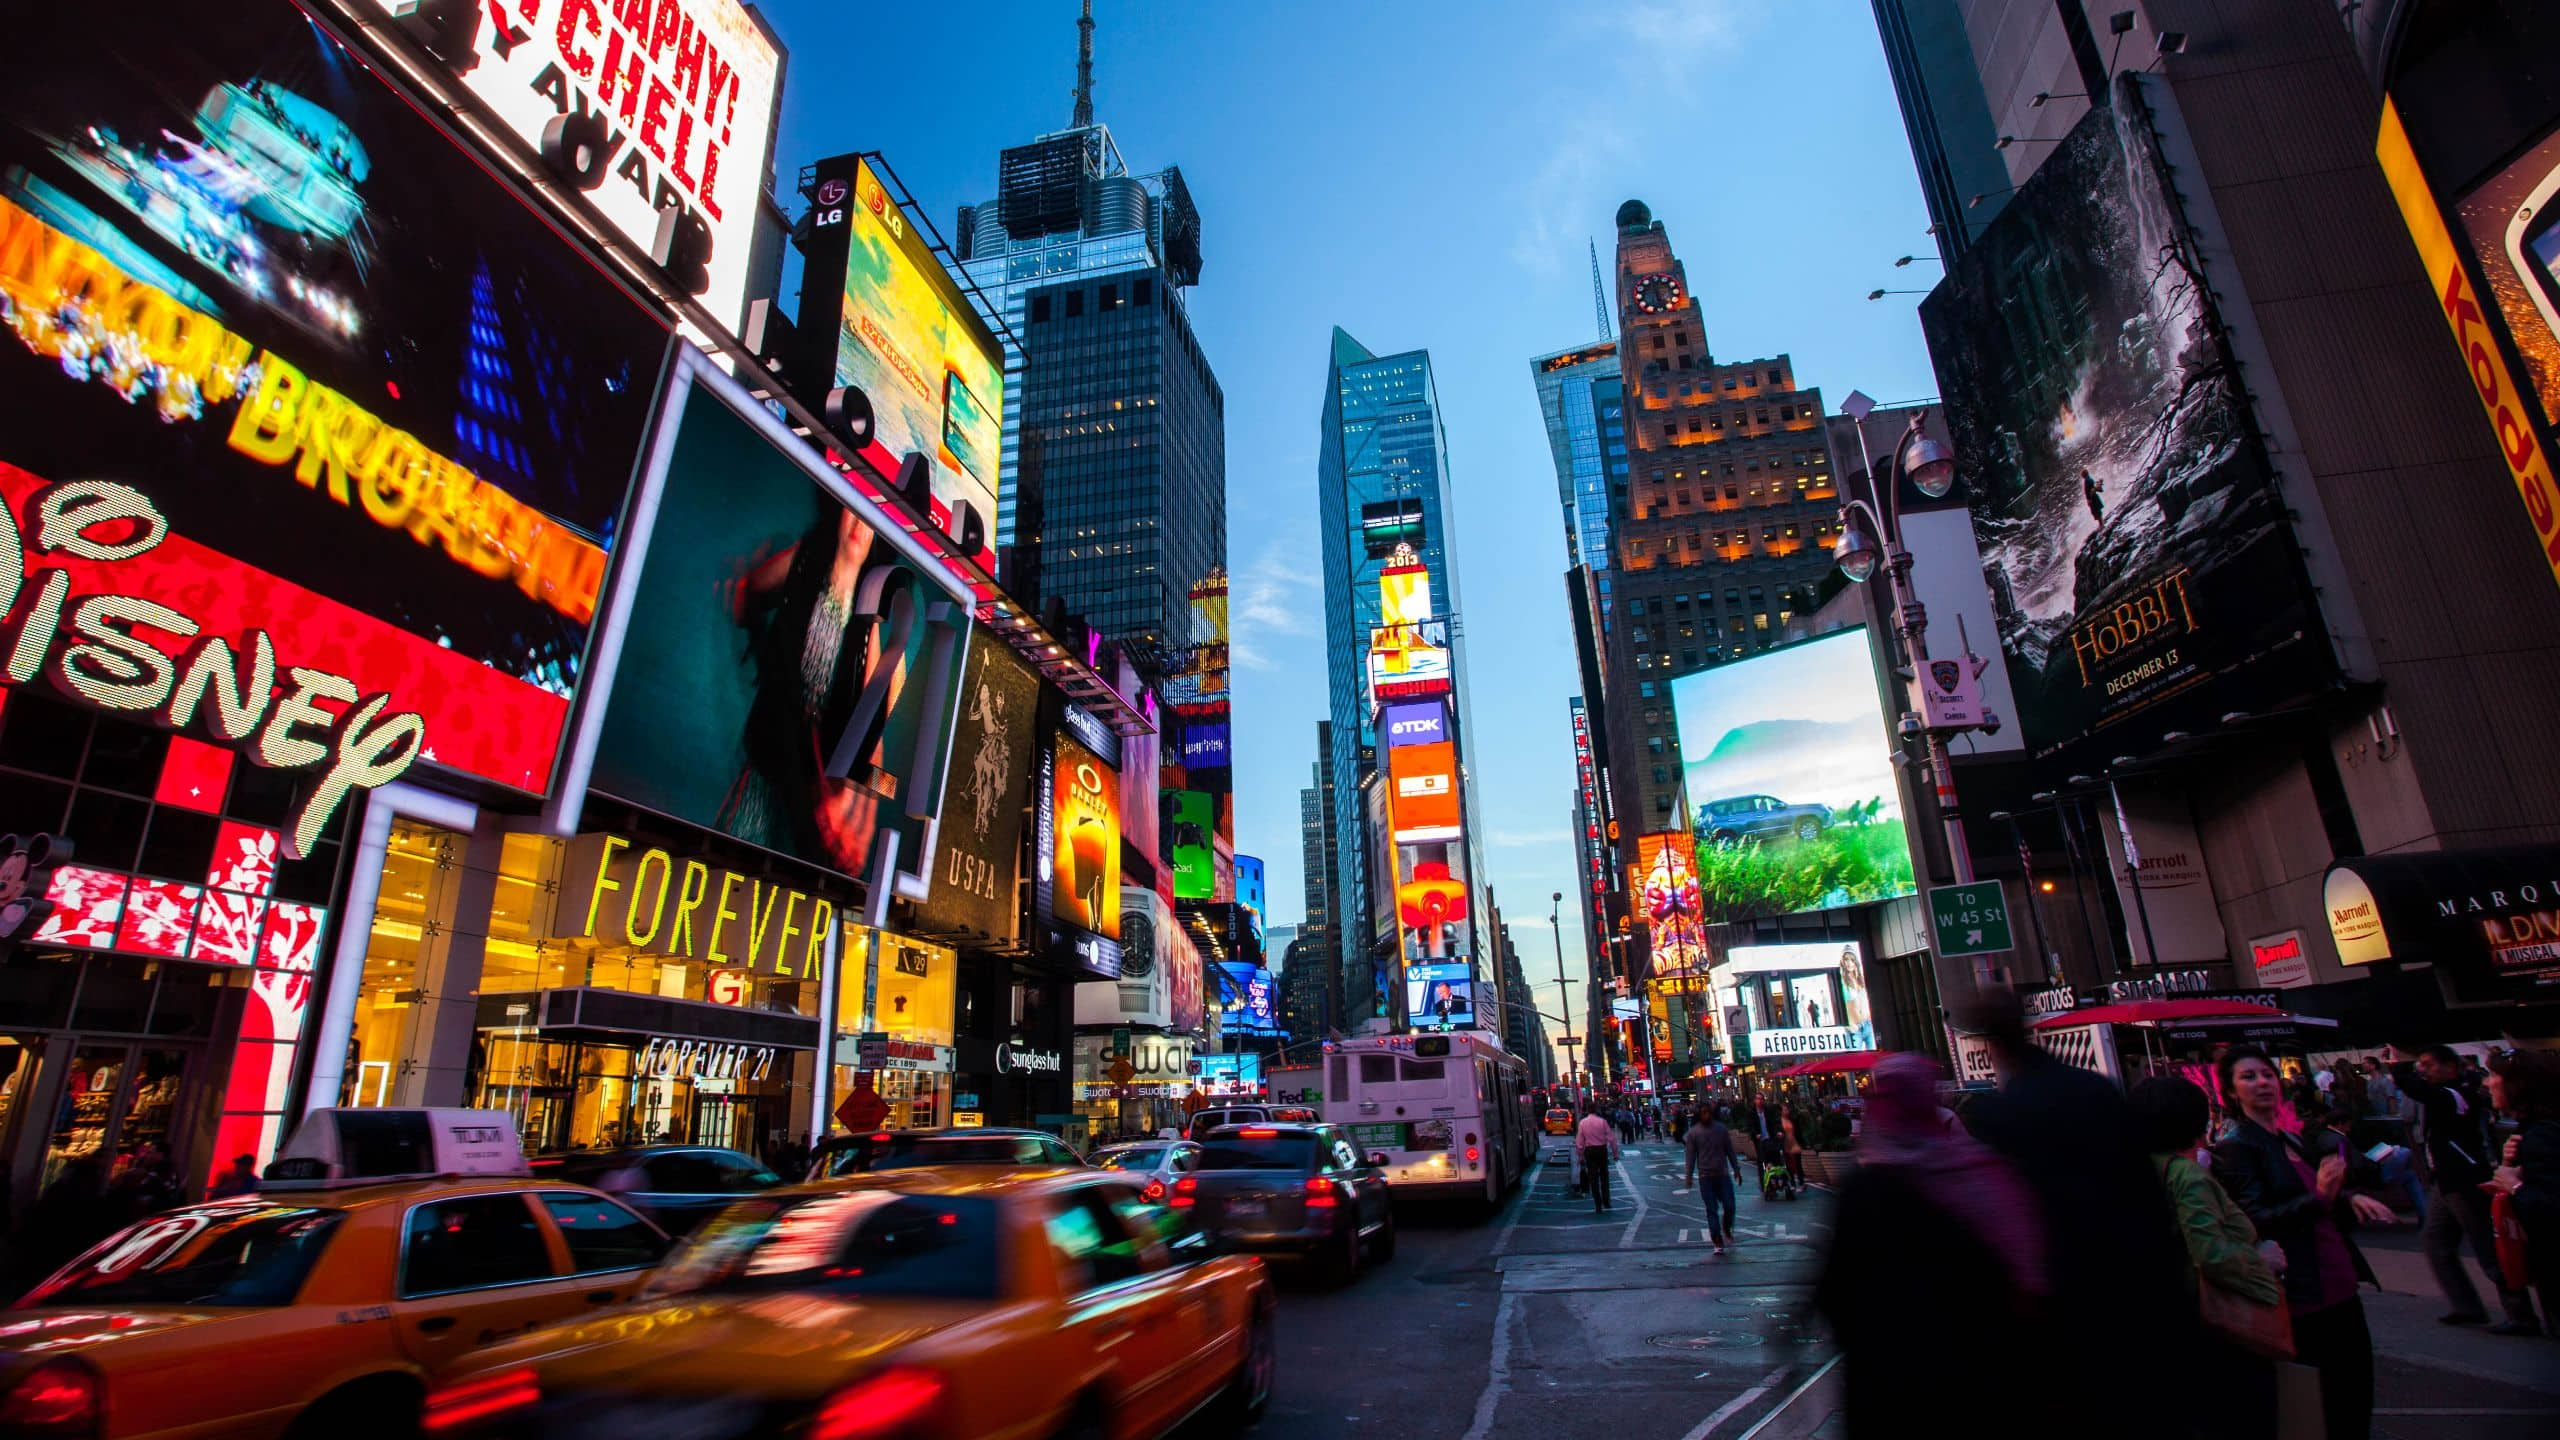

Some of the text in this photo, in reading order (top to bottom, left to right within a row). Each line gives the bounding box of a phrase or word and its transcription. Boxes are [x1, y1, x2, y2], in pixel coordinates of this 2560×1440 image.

[816, 209, 842, 227] LG
[884, 202, 903, 240] LG
[2442, 262, 2560, 567] Koda
[1387, 554, 1419, 568] 2013
[2106, 656, 2165, 696] DECEMBER
[2165, 648, 2180, 667] 13
[1376, 679, 1448, 697] TOSHIBA
[1403, 718, 1440, 734] TDK
[949, 847, 995, 900] USPA
[2124, 853, 2188, 873] arriott
[583, 834, 833, 982] FOREVER
[1939, 906, 2003, 928] W 45 St
[2333, 901, 2371, 926] Marriott
[2254, 936, 2301, 968] Marriott
[2504, 943, 2554, 961] MUSICAL
[2032, 992, 2050, 1013] HOT
[2050, 986, 2075, 1011] DOGS
[1428, 1023, 1456, 1031] SOY
[1764, 1032, 1857, 1053] AÉROPOSTALE
[642, 1037, 776, 1081] FOREVER 21
[900, 1059, 918, 1068] 1890
[1011, 1048, 1061, 1074] sunglass hut
[1278, 1087, 1323, 1105] FedEx
